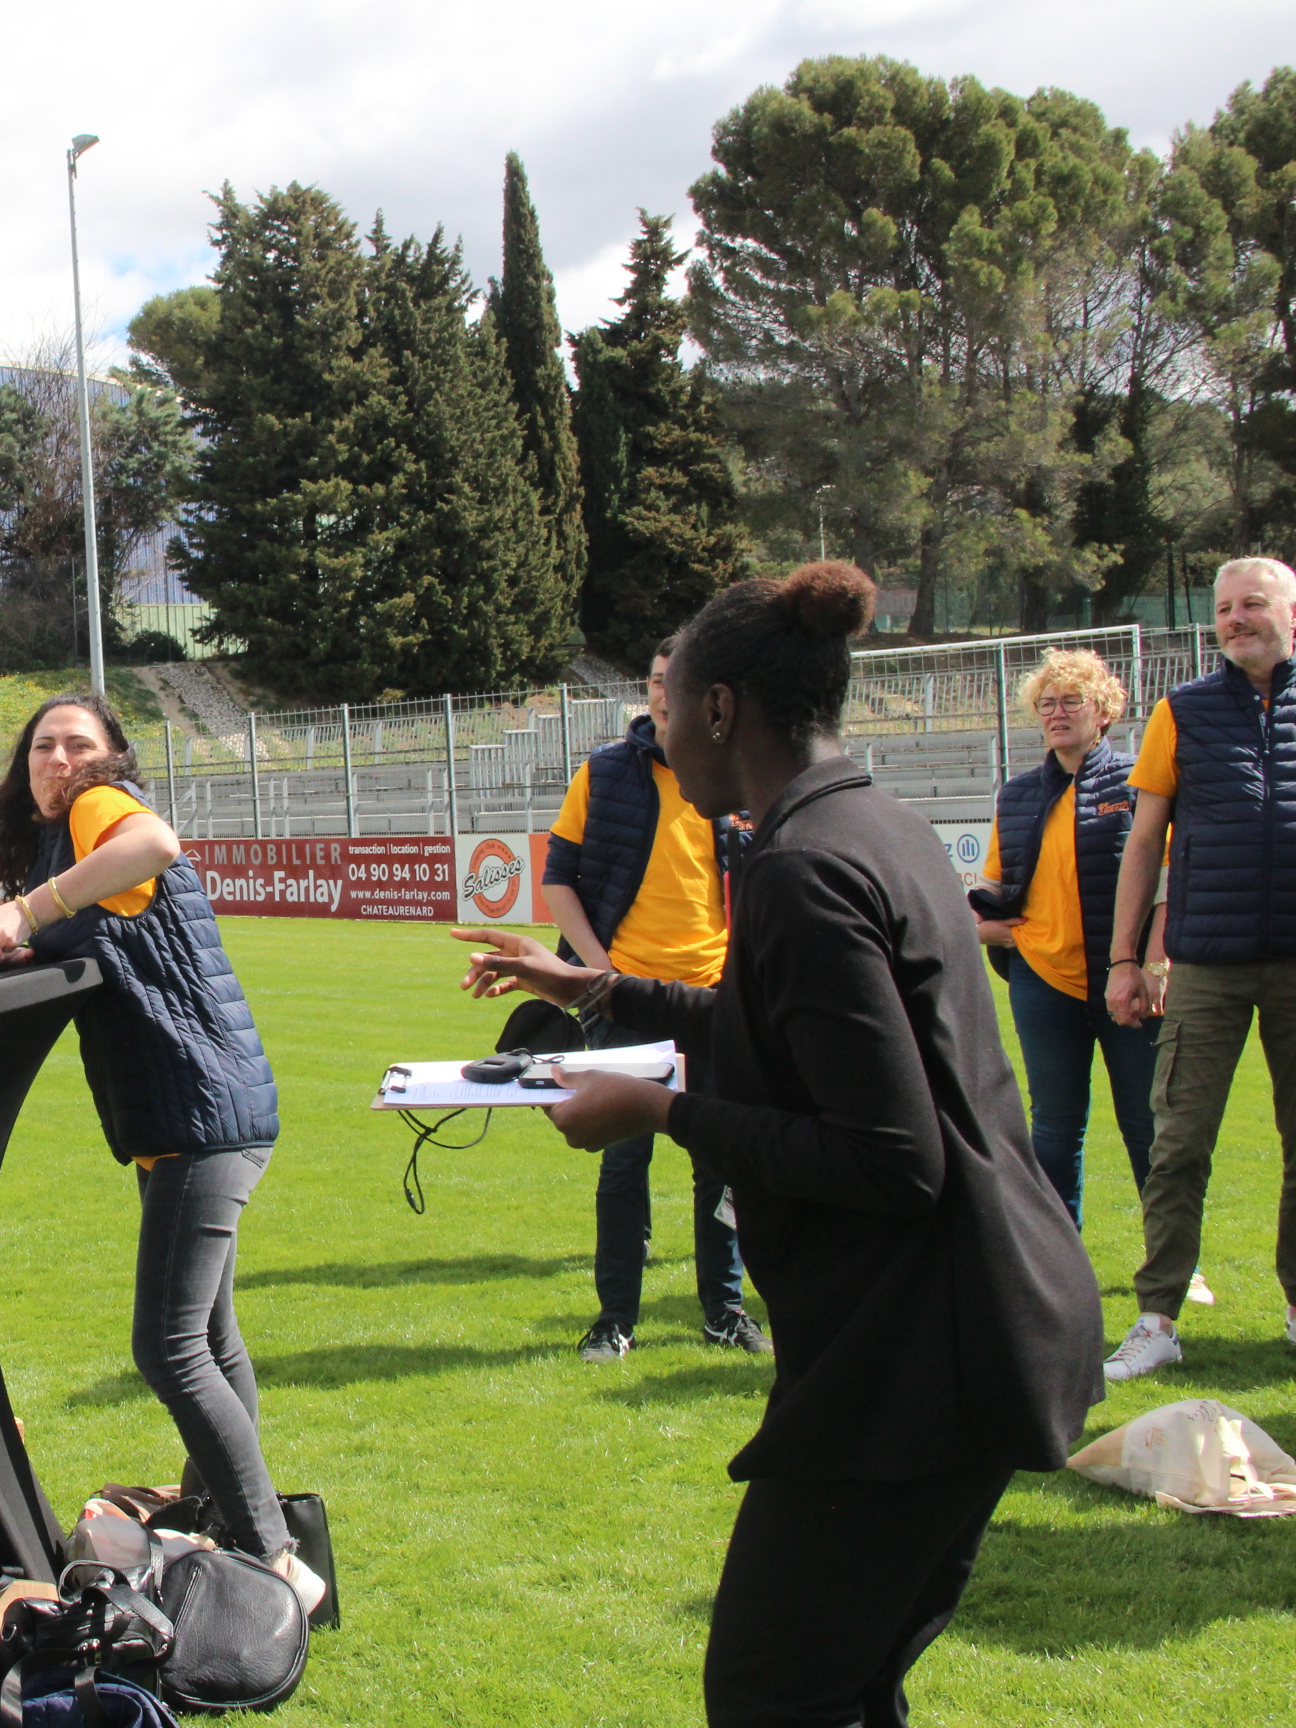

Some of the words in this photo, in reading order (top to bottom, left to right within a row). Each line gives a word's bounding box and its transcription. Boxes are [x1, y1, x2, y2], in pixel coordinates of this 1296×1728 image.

[205, 843, 342, 865] IMMOBILIER
[348, 844, 385, 855] transaction
[390, 843, 418, 854] location
[424, 843, 451, 857] gestion
[348, 863, 367, 882] 04
[370, 863, 389, 882] 90
[392, 863, 411, 882] 94
[413, 863, 430, 882] 10
[433, 863, 449, 882] 31
[463, 857, 523, 900] Salisses
[206, 869, 343, 913] Denis-Farlay
[350, 888, 451, 903] www.denis-farlay.com
[360, 905, 434, 917] CHATEAURENARD
